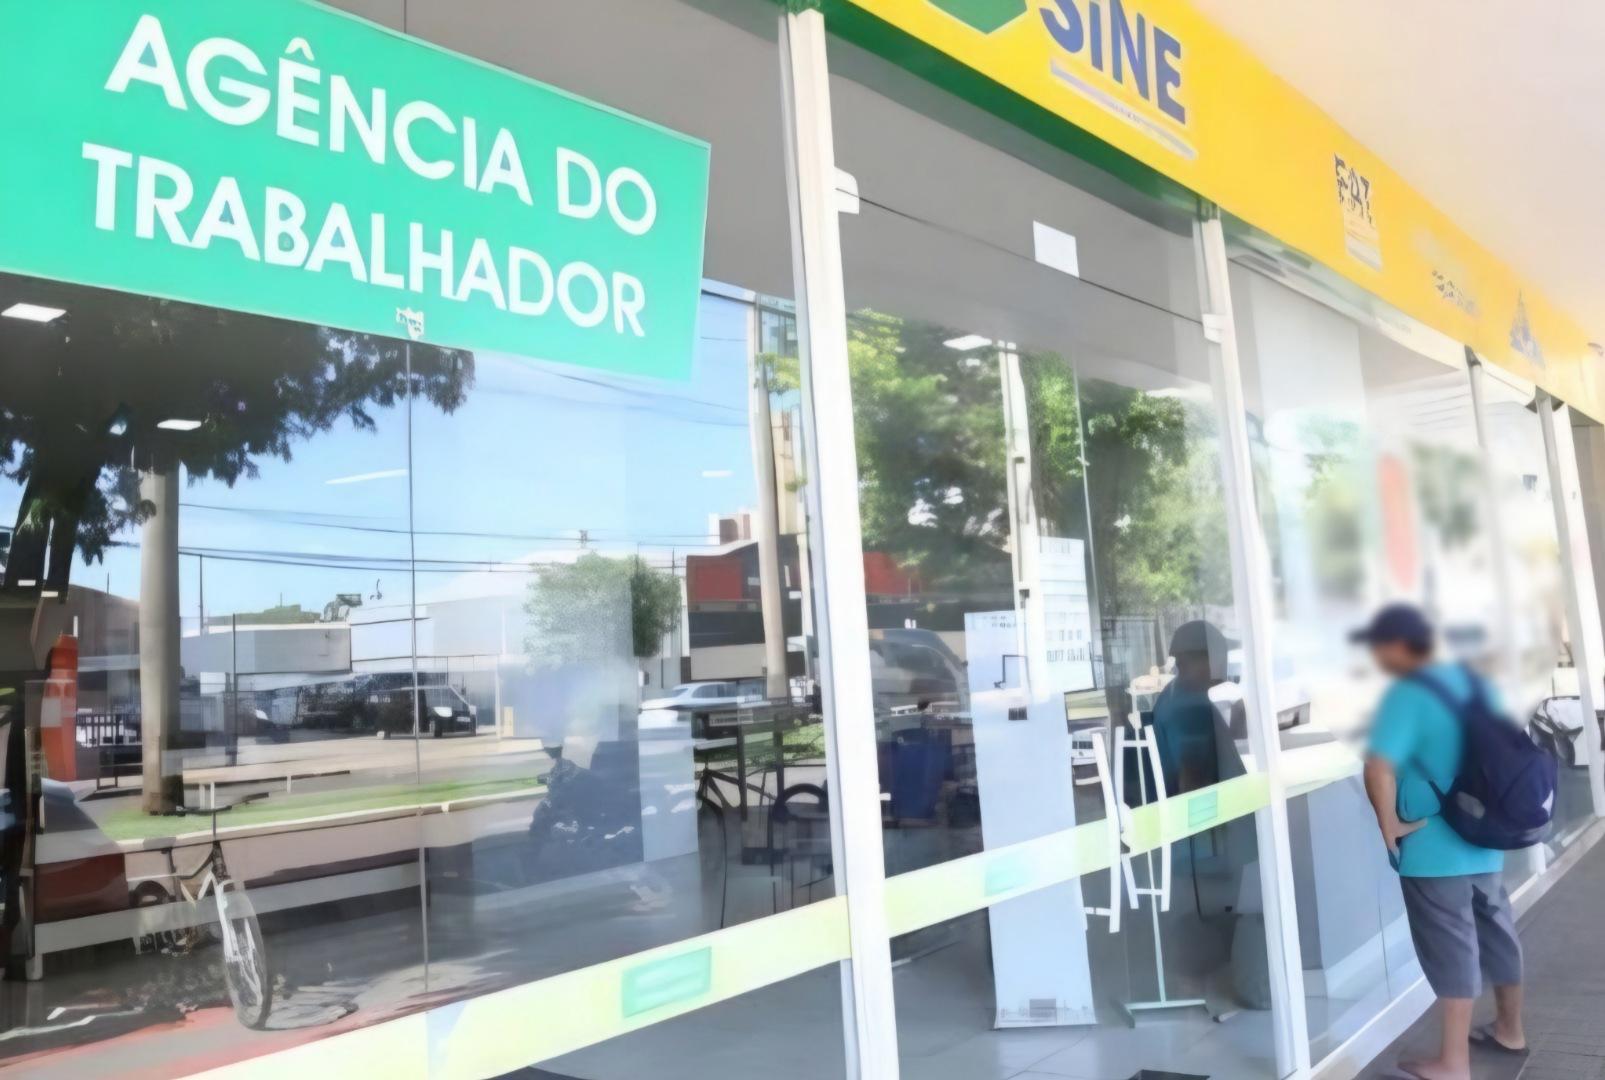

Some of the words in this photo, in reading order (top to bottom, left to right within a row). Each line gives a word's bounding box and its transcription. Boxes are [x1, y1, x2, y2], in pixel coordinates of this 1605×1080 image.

[104, 14, 533, 206] AGÊNCIA
[556, 147, 658, 237] DO
[82, 142, 646, 338] TRABALHADOR
